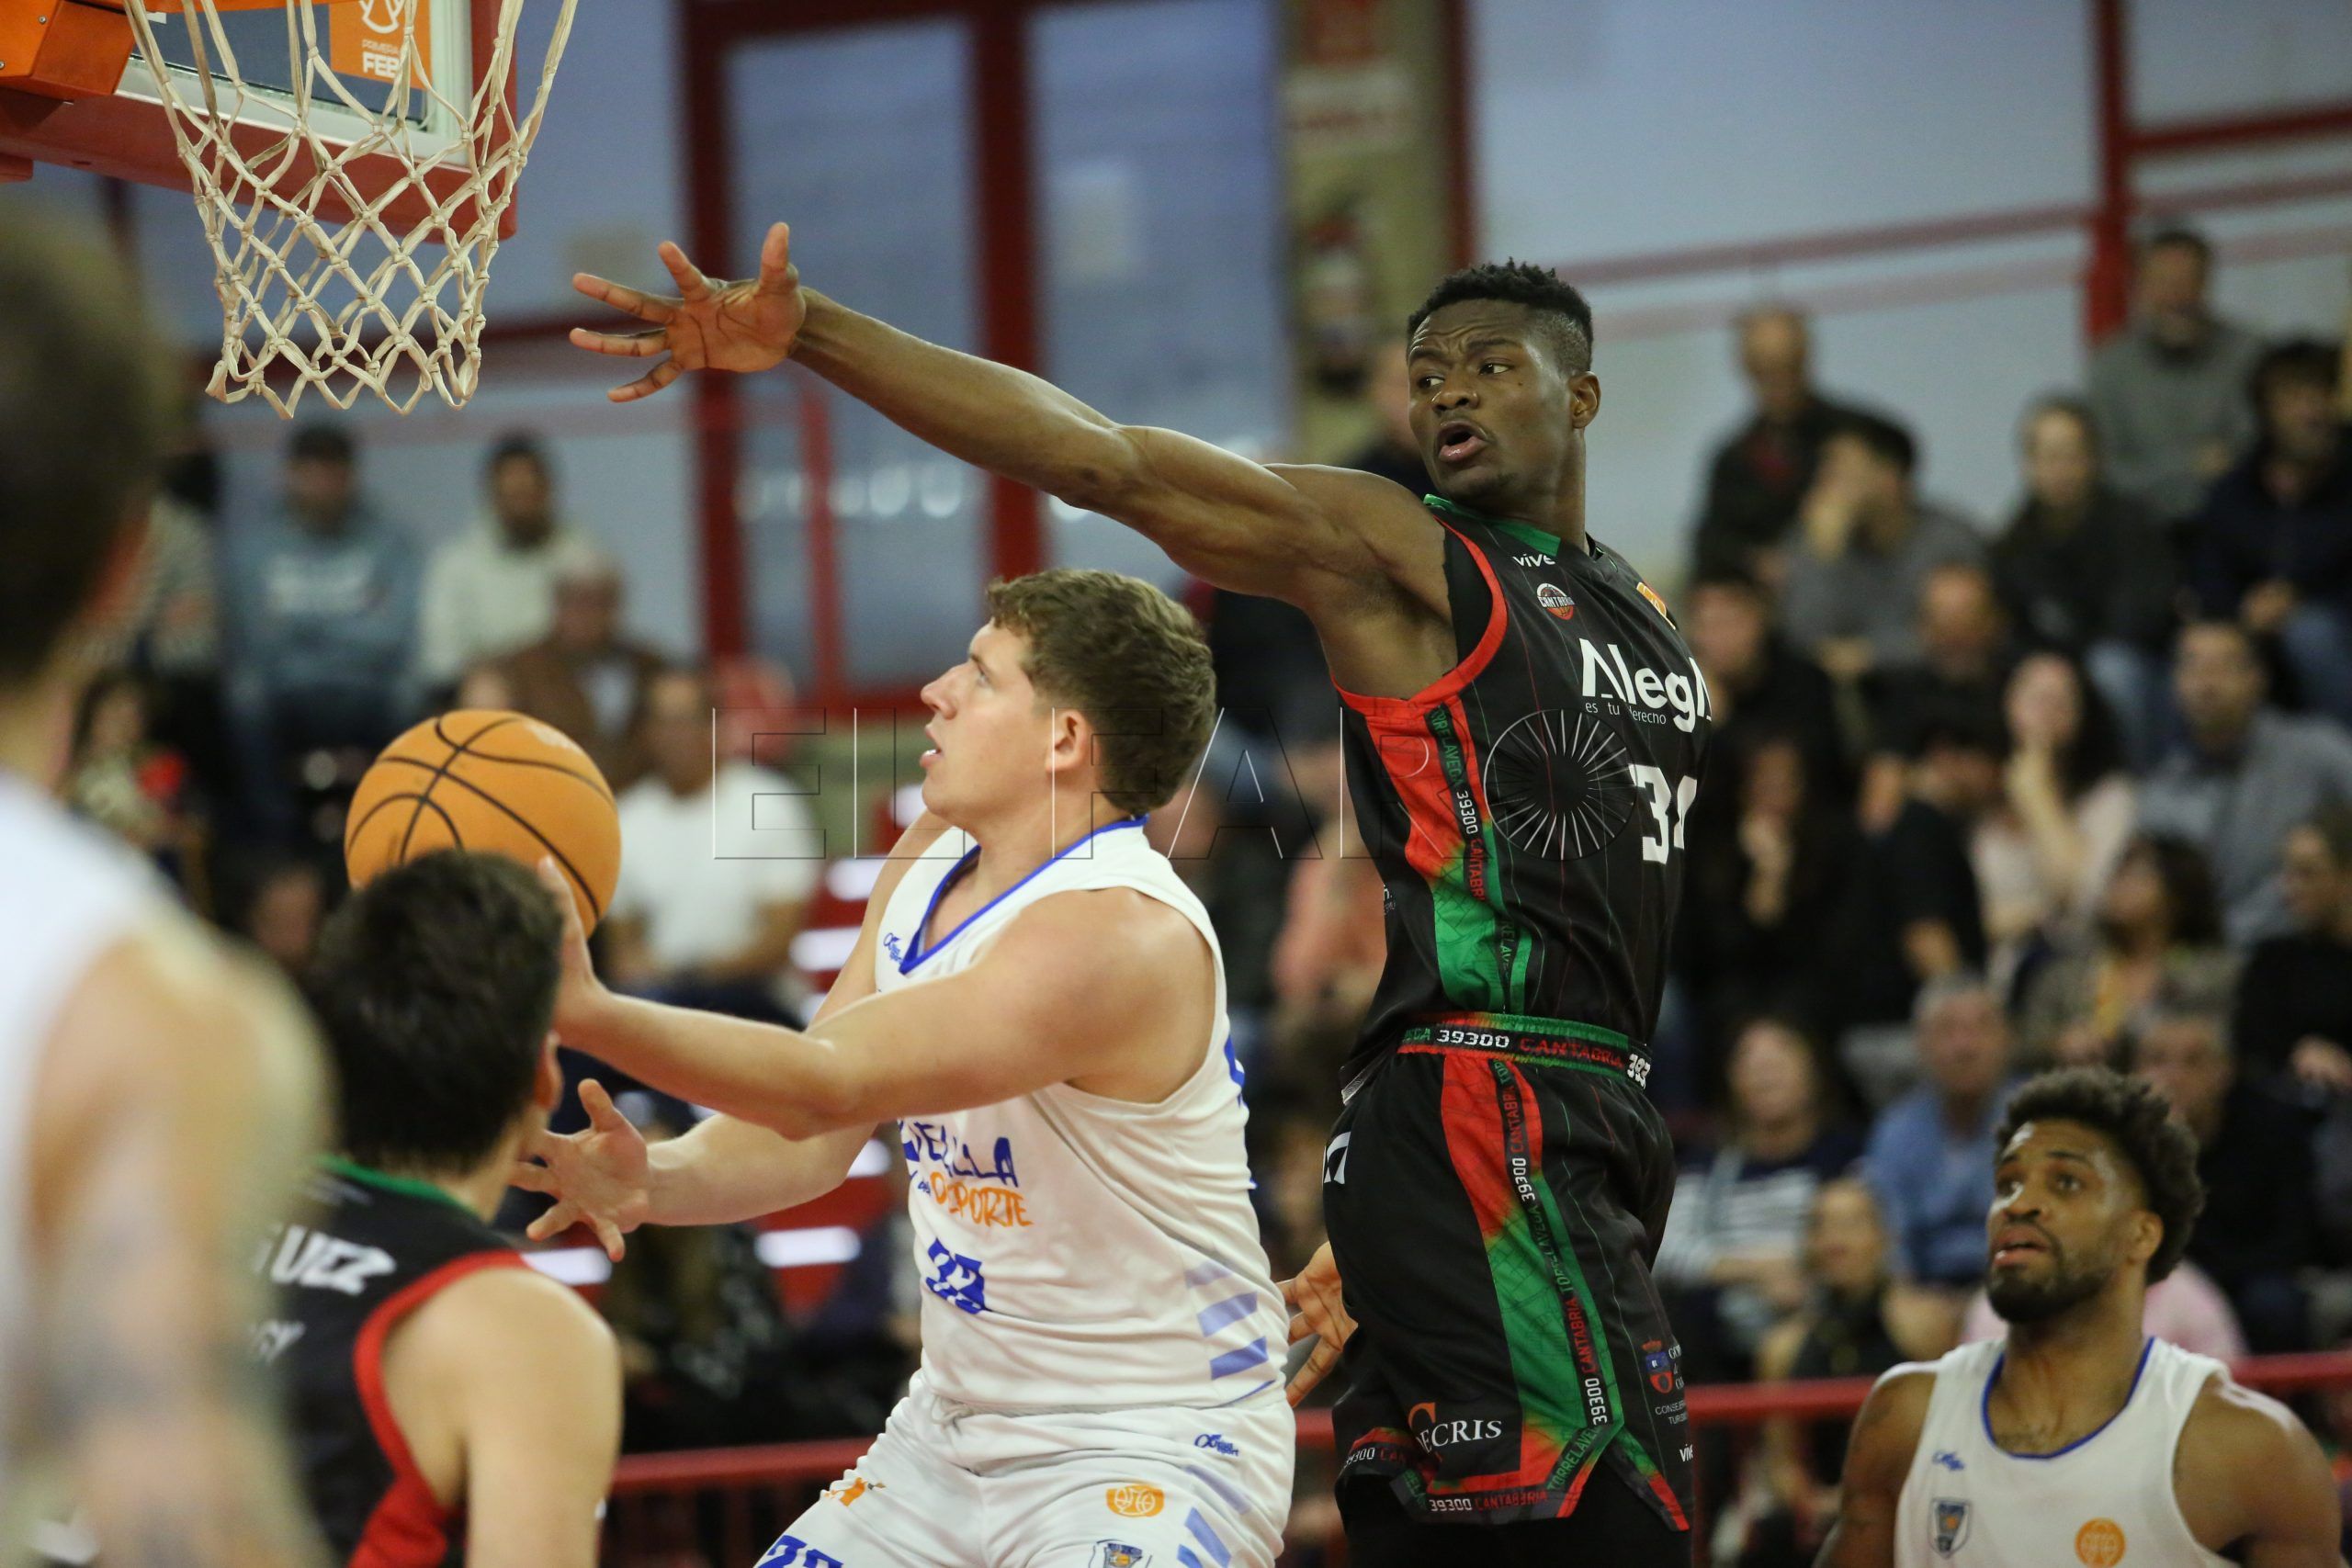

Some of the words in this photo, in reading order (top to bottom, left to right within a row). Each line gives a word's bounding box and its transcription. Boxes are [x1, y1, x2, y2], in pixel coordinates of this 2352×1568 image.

[1585, 702, 1599, 714] es
[1607, 702, 1620, 716] tu
[1456, 790, 1479, 835] 39300
[1436, 1029, 1510, 1049] 39300
[1519, 1036, 1626, 1069] CANTABRIA
[1626, 1054, 1652, 1090] 393
[1511, 1157, 1535, 1201] 39300
[1566, 1296, 1598, 1374] CANTABRIA
[1584, 1377, 1608, 1426] 39300
[1429, 1498, 1472, 1512] 39300
